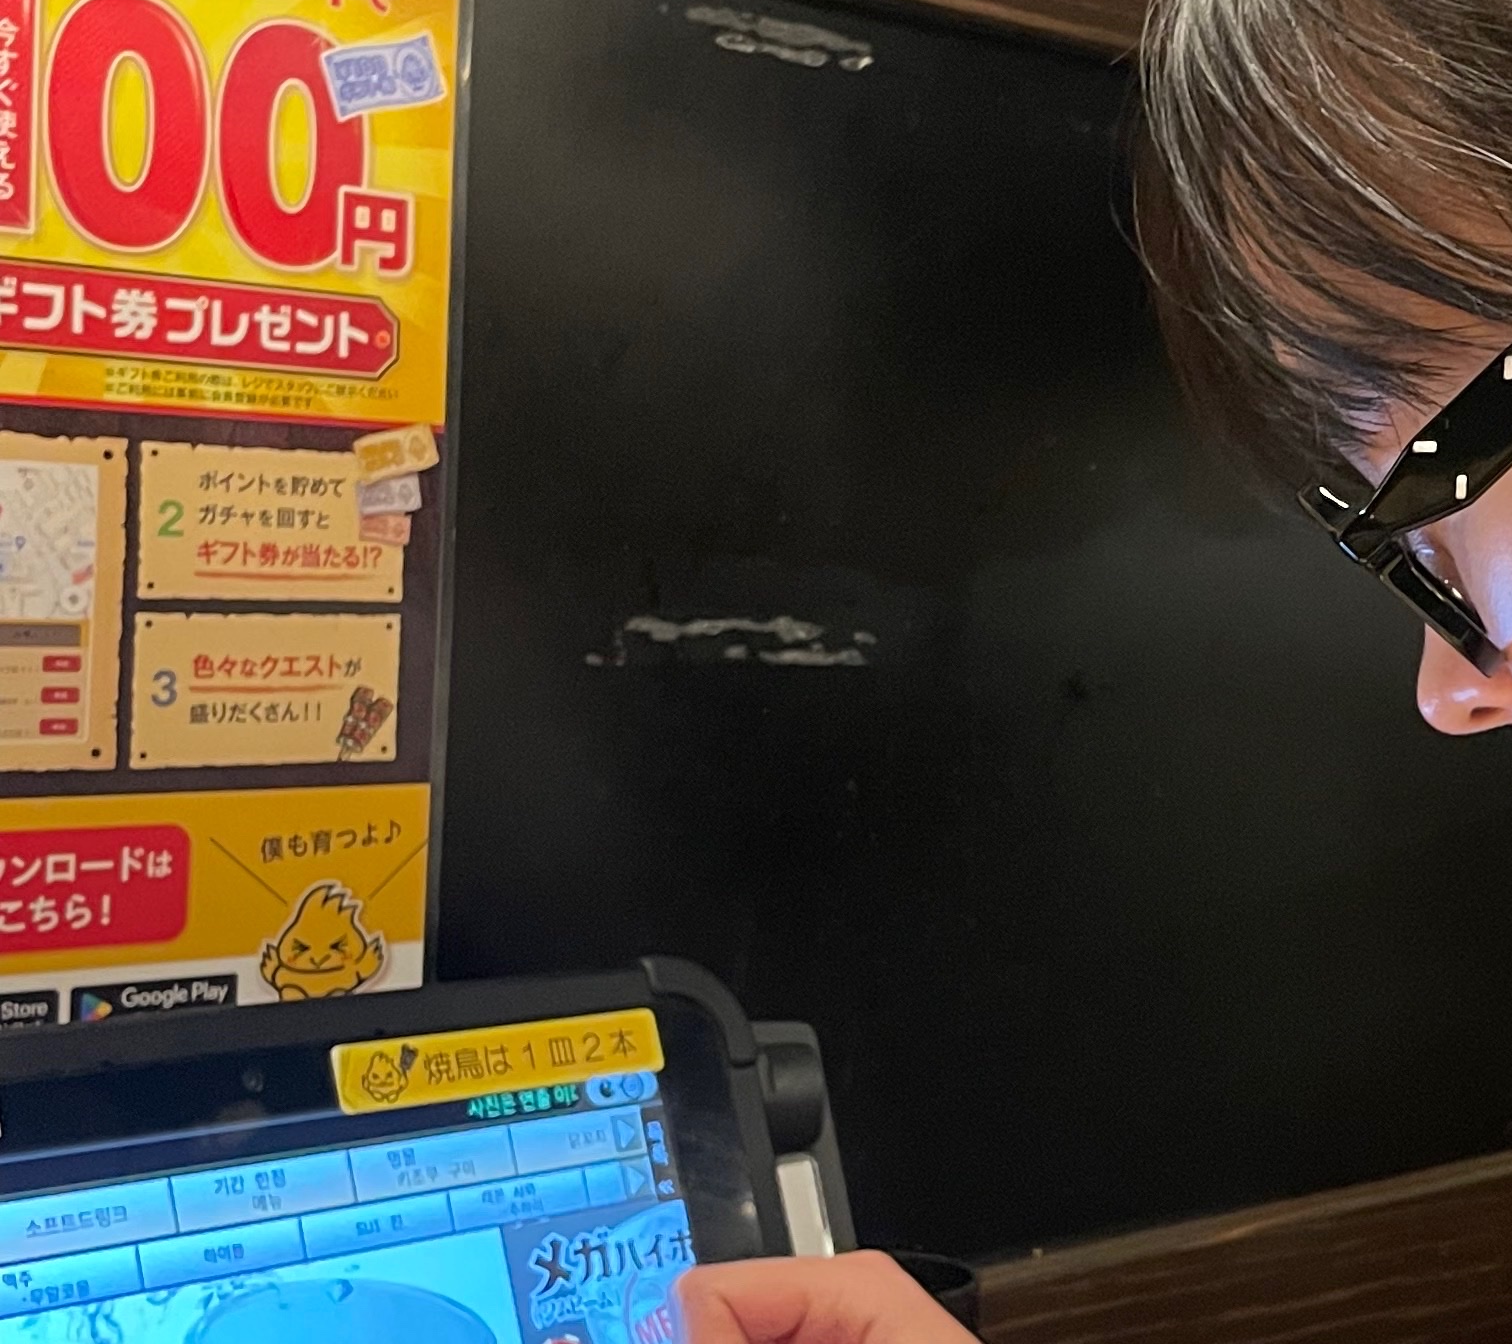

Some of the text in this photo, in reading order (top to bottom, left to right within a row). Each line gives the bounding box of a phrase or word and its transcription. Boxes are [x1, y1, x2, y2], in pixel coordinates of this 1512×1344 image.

[199, 471, 347, 500] ポイントを貯めて
[157, 500, 184, 537] 2
[199, 504, 331, 531] ガチャを回すと
[192, 654, 362, 682] 色々なクエストが
[151, 669, 178, 708] 3
[120, 980, 229, 1009] Google Play
[1, 999, 49, 1020] Store
